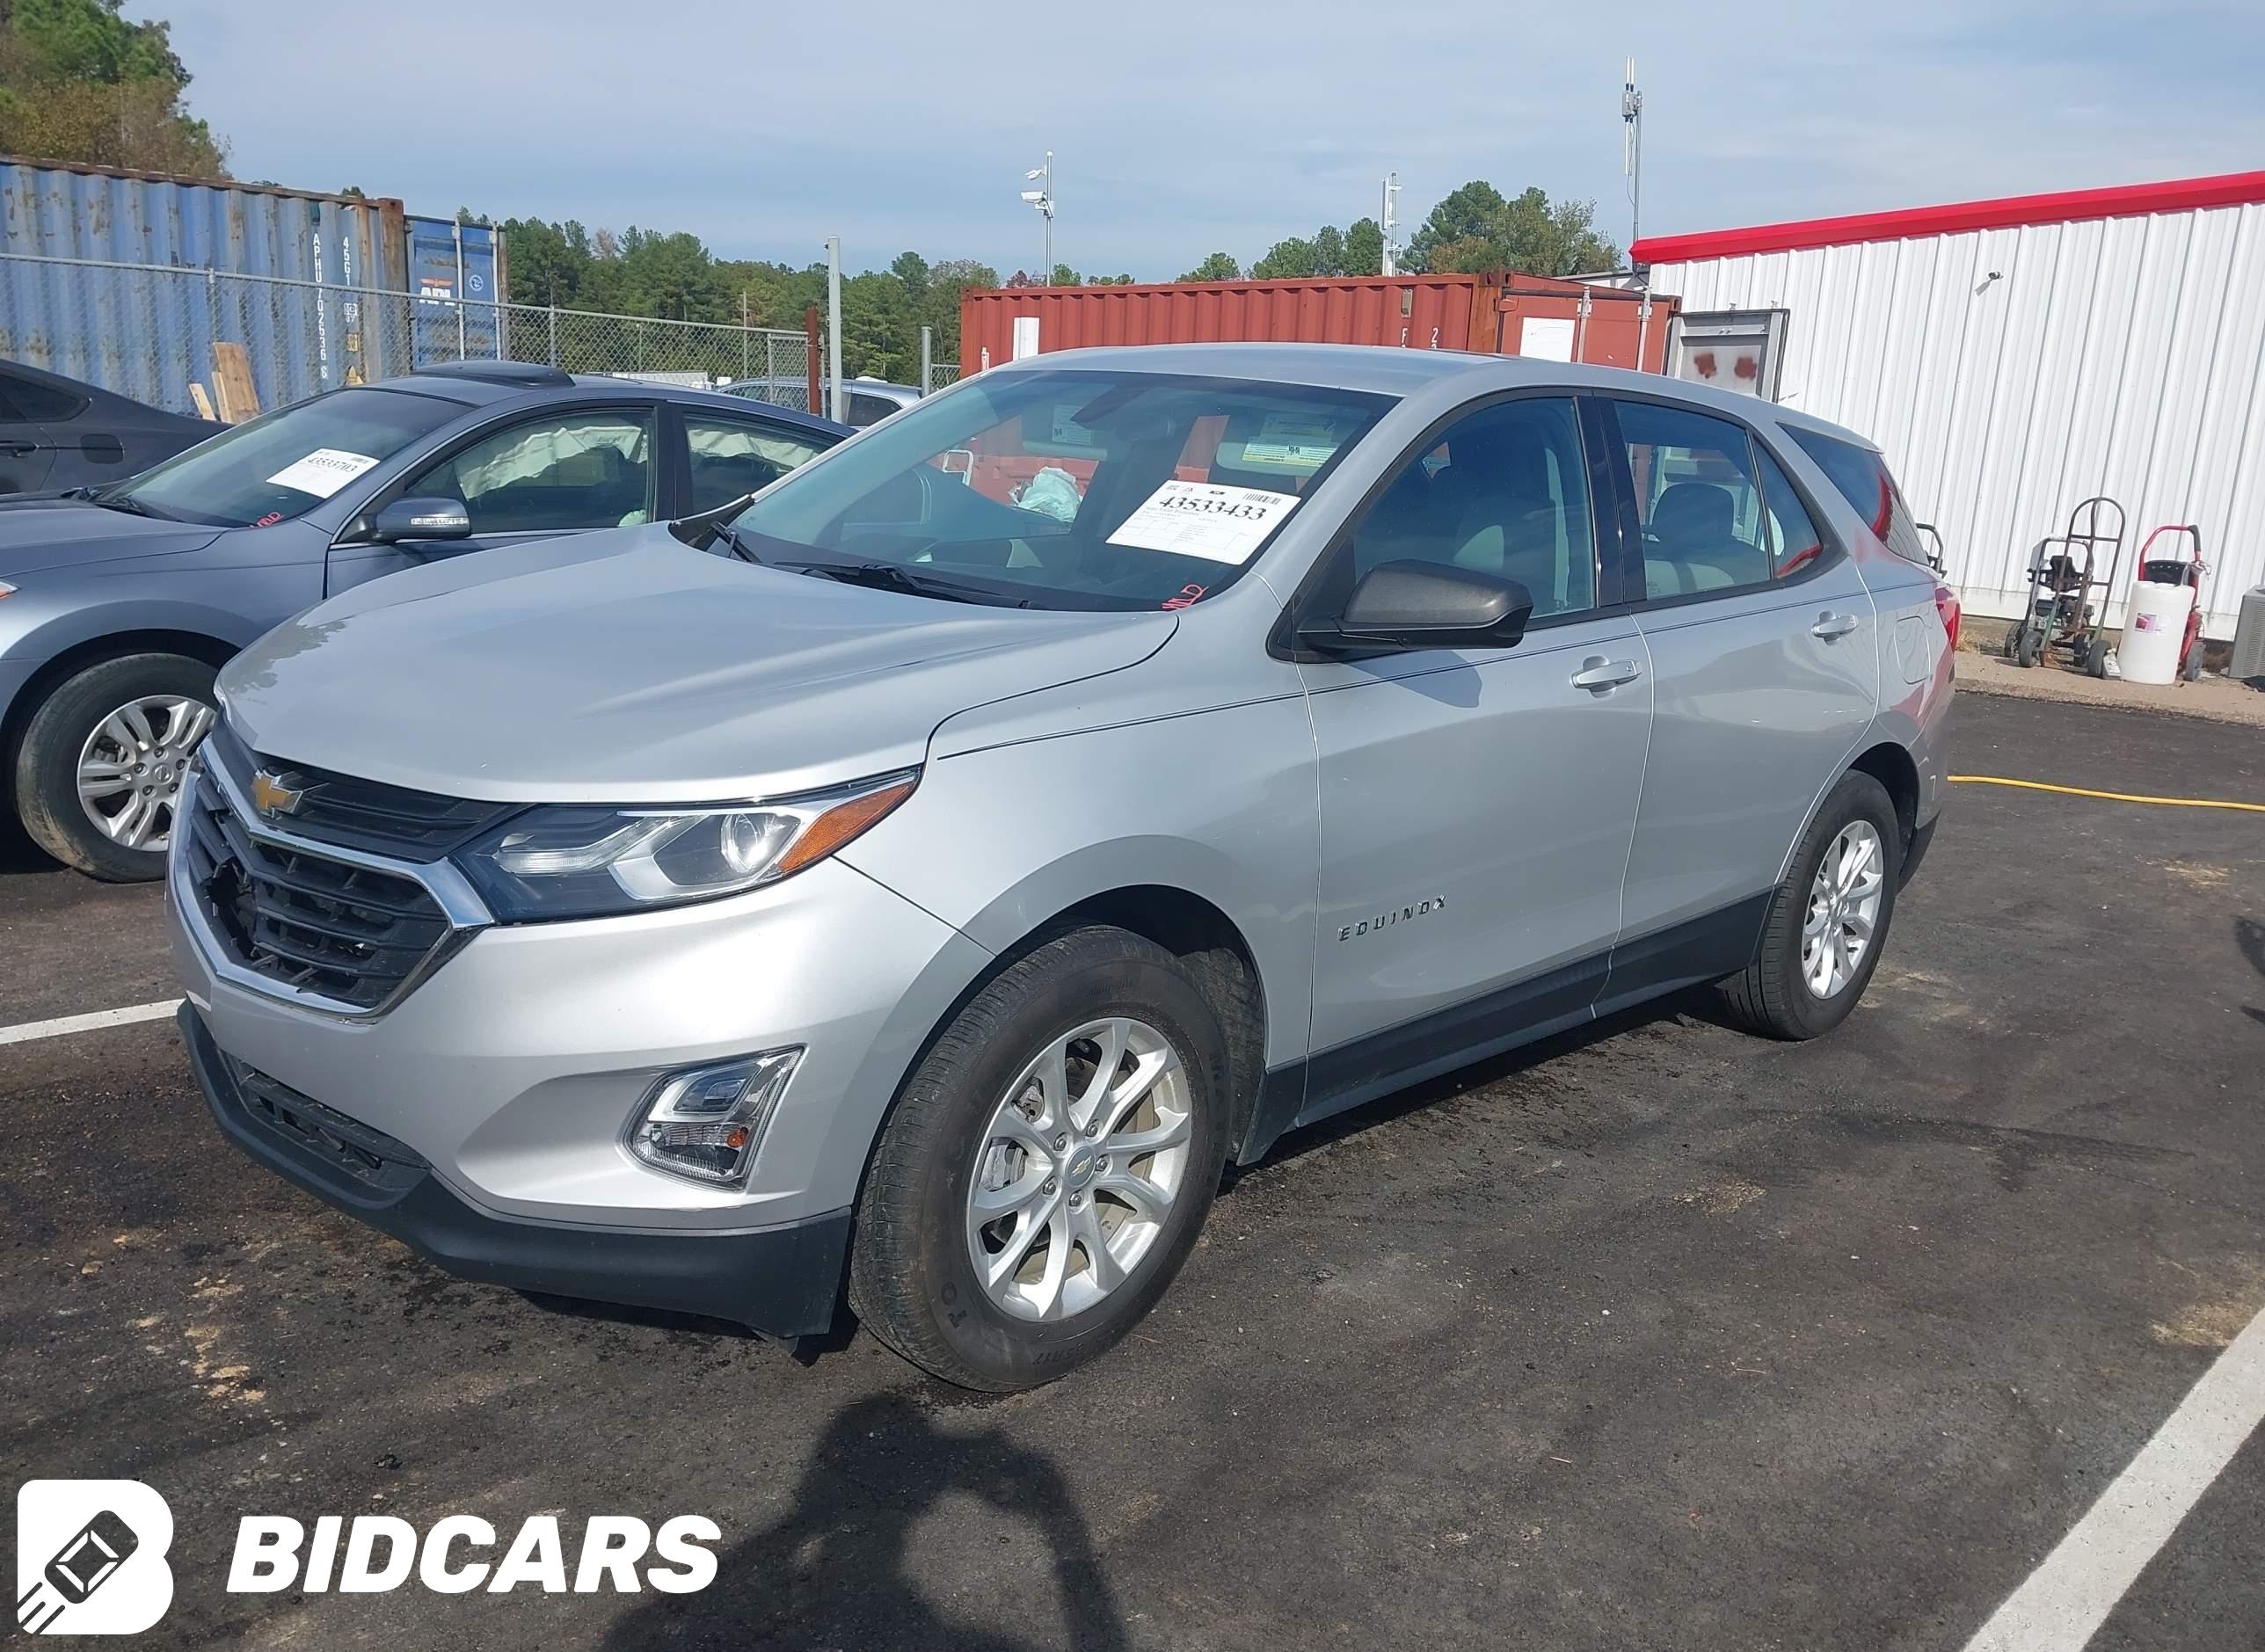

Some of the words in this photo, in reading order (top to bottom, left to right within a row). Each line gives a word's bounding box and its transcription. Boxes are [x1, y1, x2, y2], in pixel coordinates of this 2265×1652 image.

[313, 233, 323, 282] APHU
[1159, 495, 1267, 520] 43533433
[1337, 894, 1446, 942] EQUINOX
